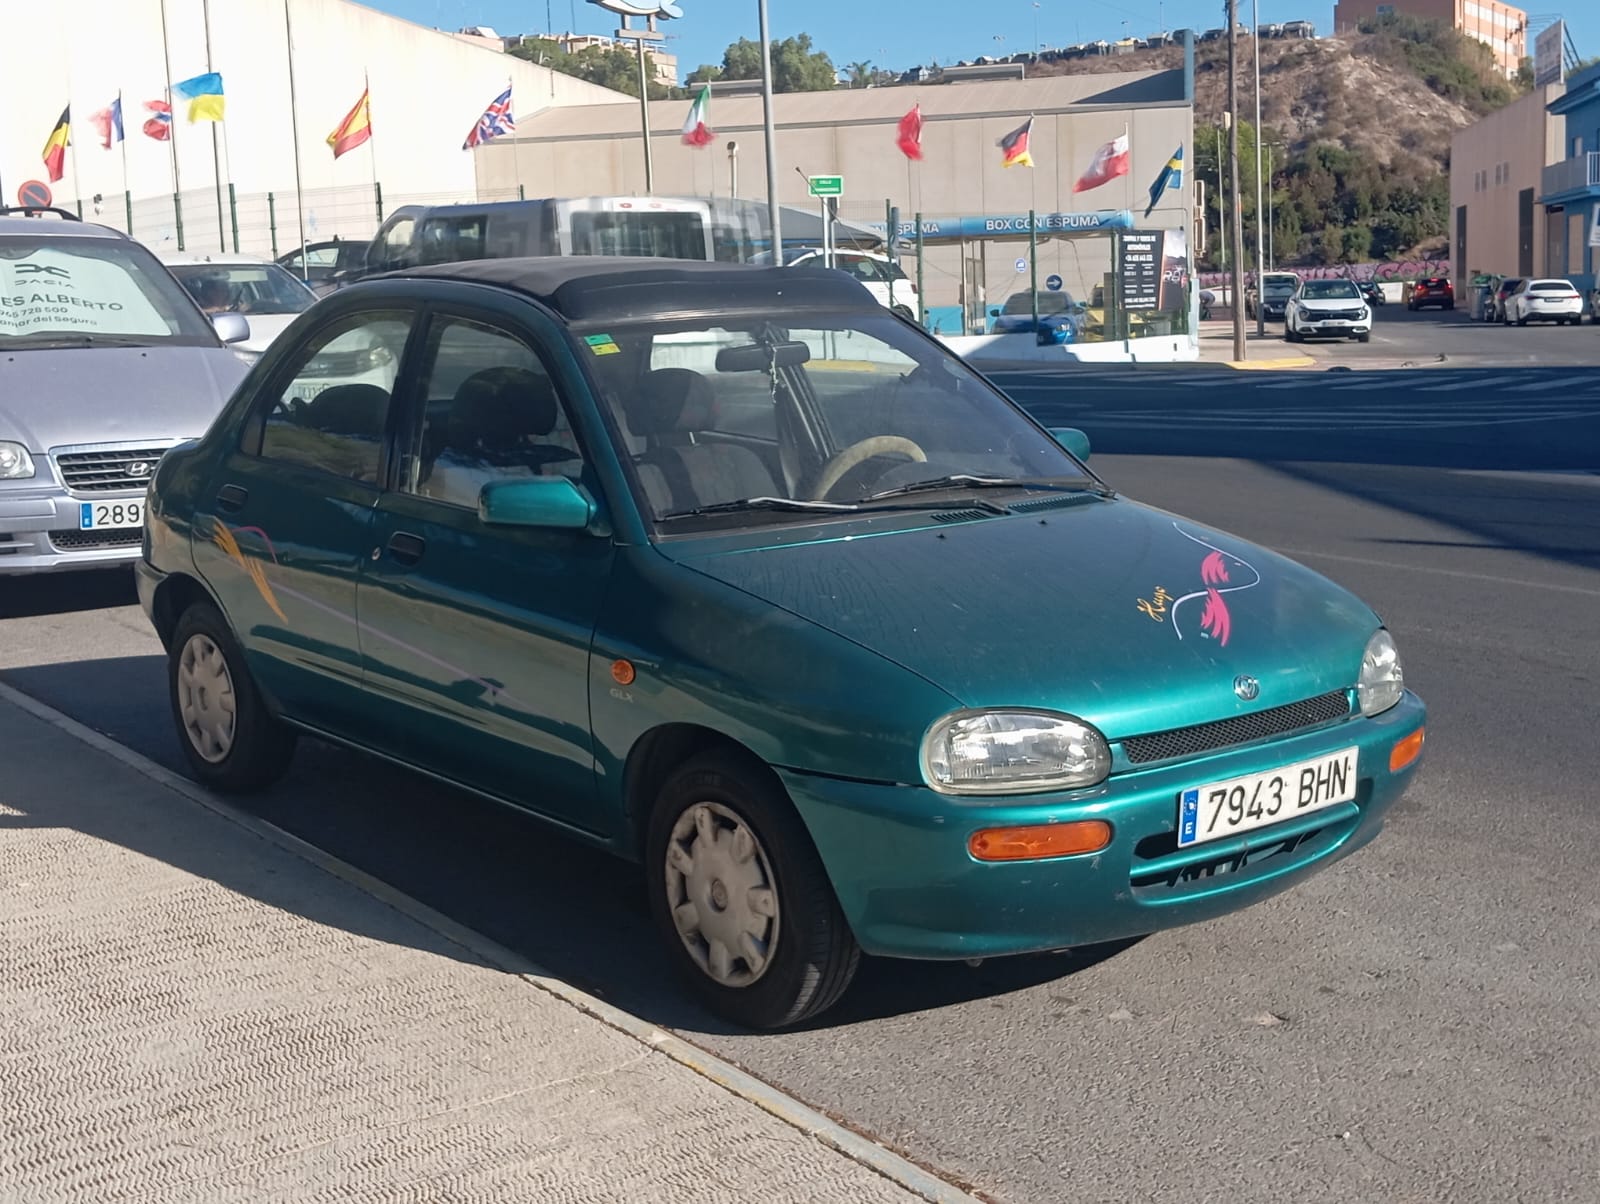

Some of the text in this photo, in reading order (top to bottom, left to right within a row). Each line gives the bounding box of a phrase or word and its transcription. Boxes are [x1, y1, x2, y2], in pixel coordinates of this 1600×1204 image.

[985, 215, 1100, 231] BOX CON ESPUMA
[14, 279, 75, 289] DACIA
[31, 293, 123, 311] ALBERTO
[21, 306, 42, 316] 728
[33, 315, 52, 323] del
[96, 503, 145, 526] 289
[609, 687, 634, 705] GLX
[1184, 756, 1350, 835] E 7943 BHN
